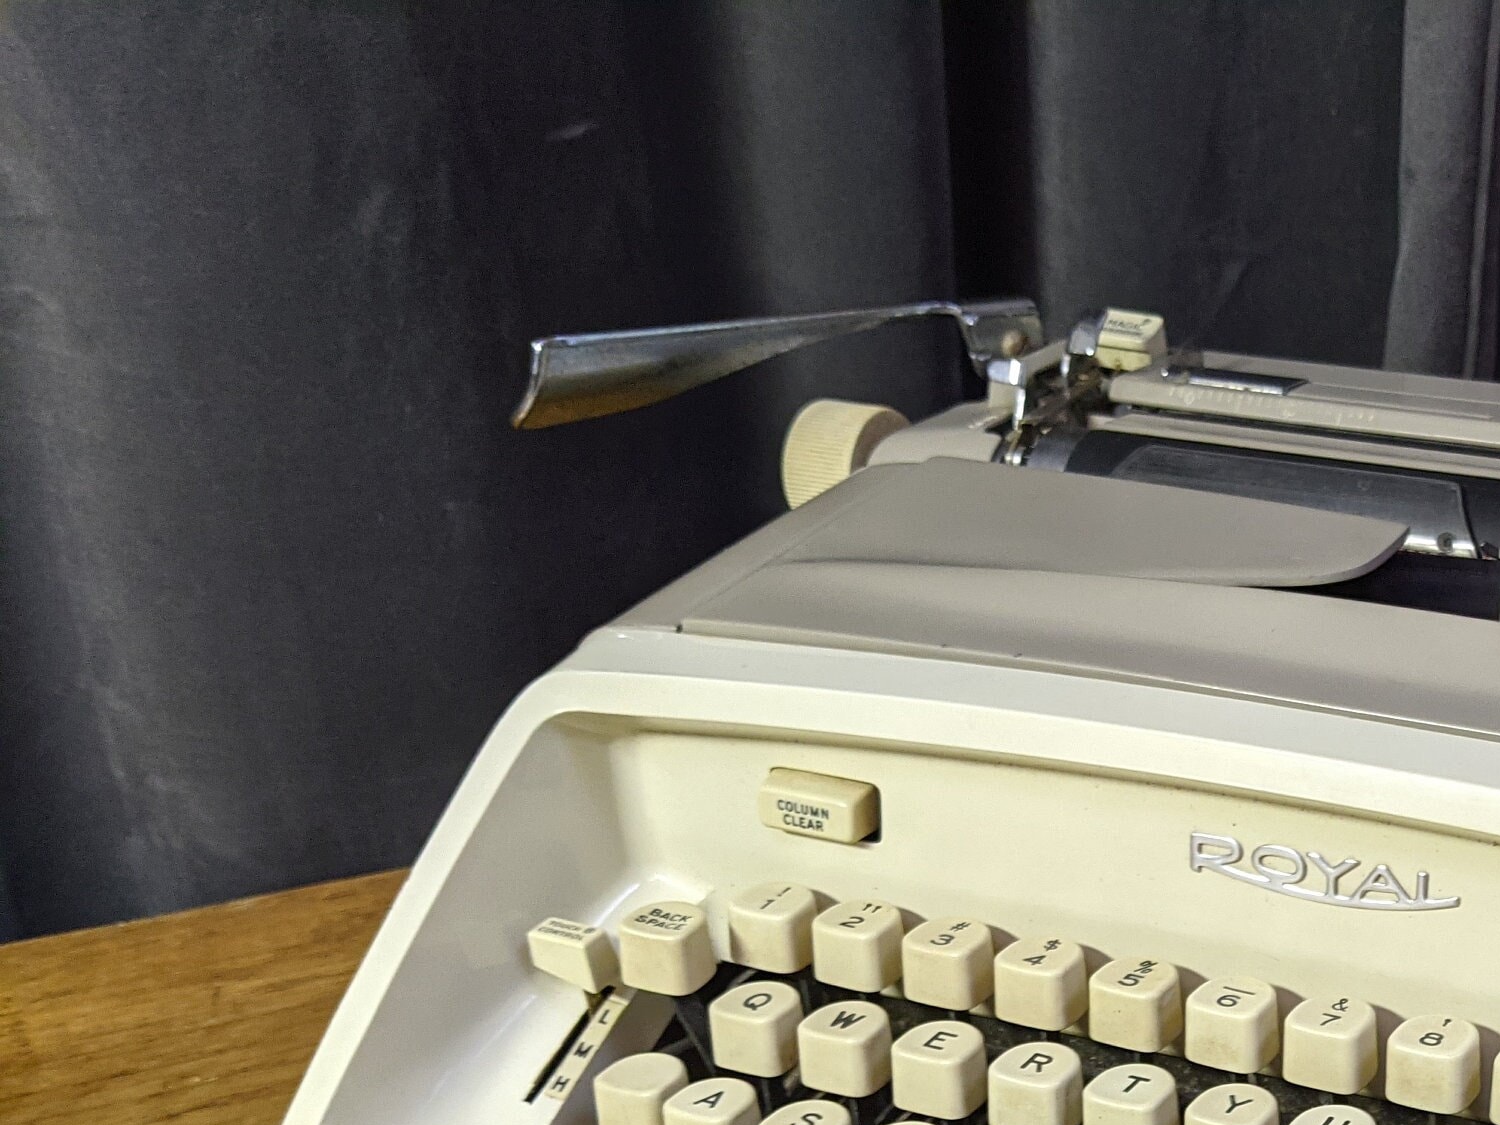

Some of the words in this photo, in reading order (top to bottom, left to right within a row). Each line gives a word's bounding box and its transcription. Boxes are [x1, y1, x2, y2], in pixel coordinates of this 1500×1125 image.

[777, 799, 829, 820] COLUMN
[783, 814, 824, 832] CLEAR
[1190, 831, 1461, 911] ROYAL
[634, 915, 687, 931] SPACE
[649, 908, 692, 922] BACK
[838, 916, 865, 929] 2
[949, 921, 971, 932] #
[929, 933, 956, 946] 3
[1043, 939, 1062, 952] $
[1022, 954, 1047, 966] 4
[1133, 960, 1158, 974] %
[1117, 973, 1145, 987] 5
[742, 992, 773, 1011] Q
[1216, 994, 1241, 1008] 6
[1331, 998, 1349, 1012] &
[598, 1009, 610, 1025] L
[830, 1010, 867, 1029] W
[1319, 1012, 1342, 1026] 7
[922, 1031, 958, 1051] E
[1418, 1032, 1444, 1047] 8
[574, 1042, 593, 1058] M
[1019, 1052, 1054, 1073] R
[551, 1075, 570, 1092] H
[1122, 1075, 1151, 1093] T
[692, 1091, 724, 1109] A
[1225, 1094, 1254, 1114] Y
